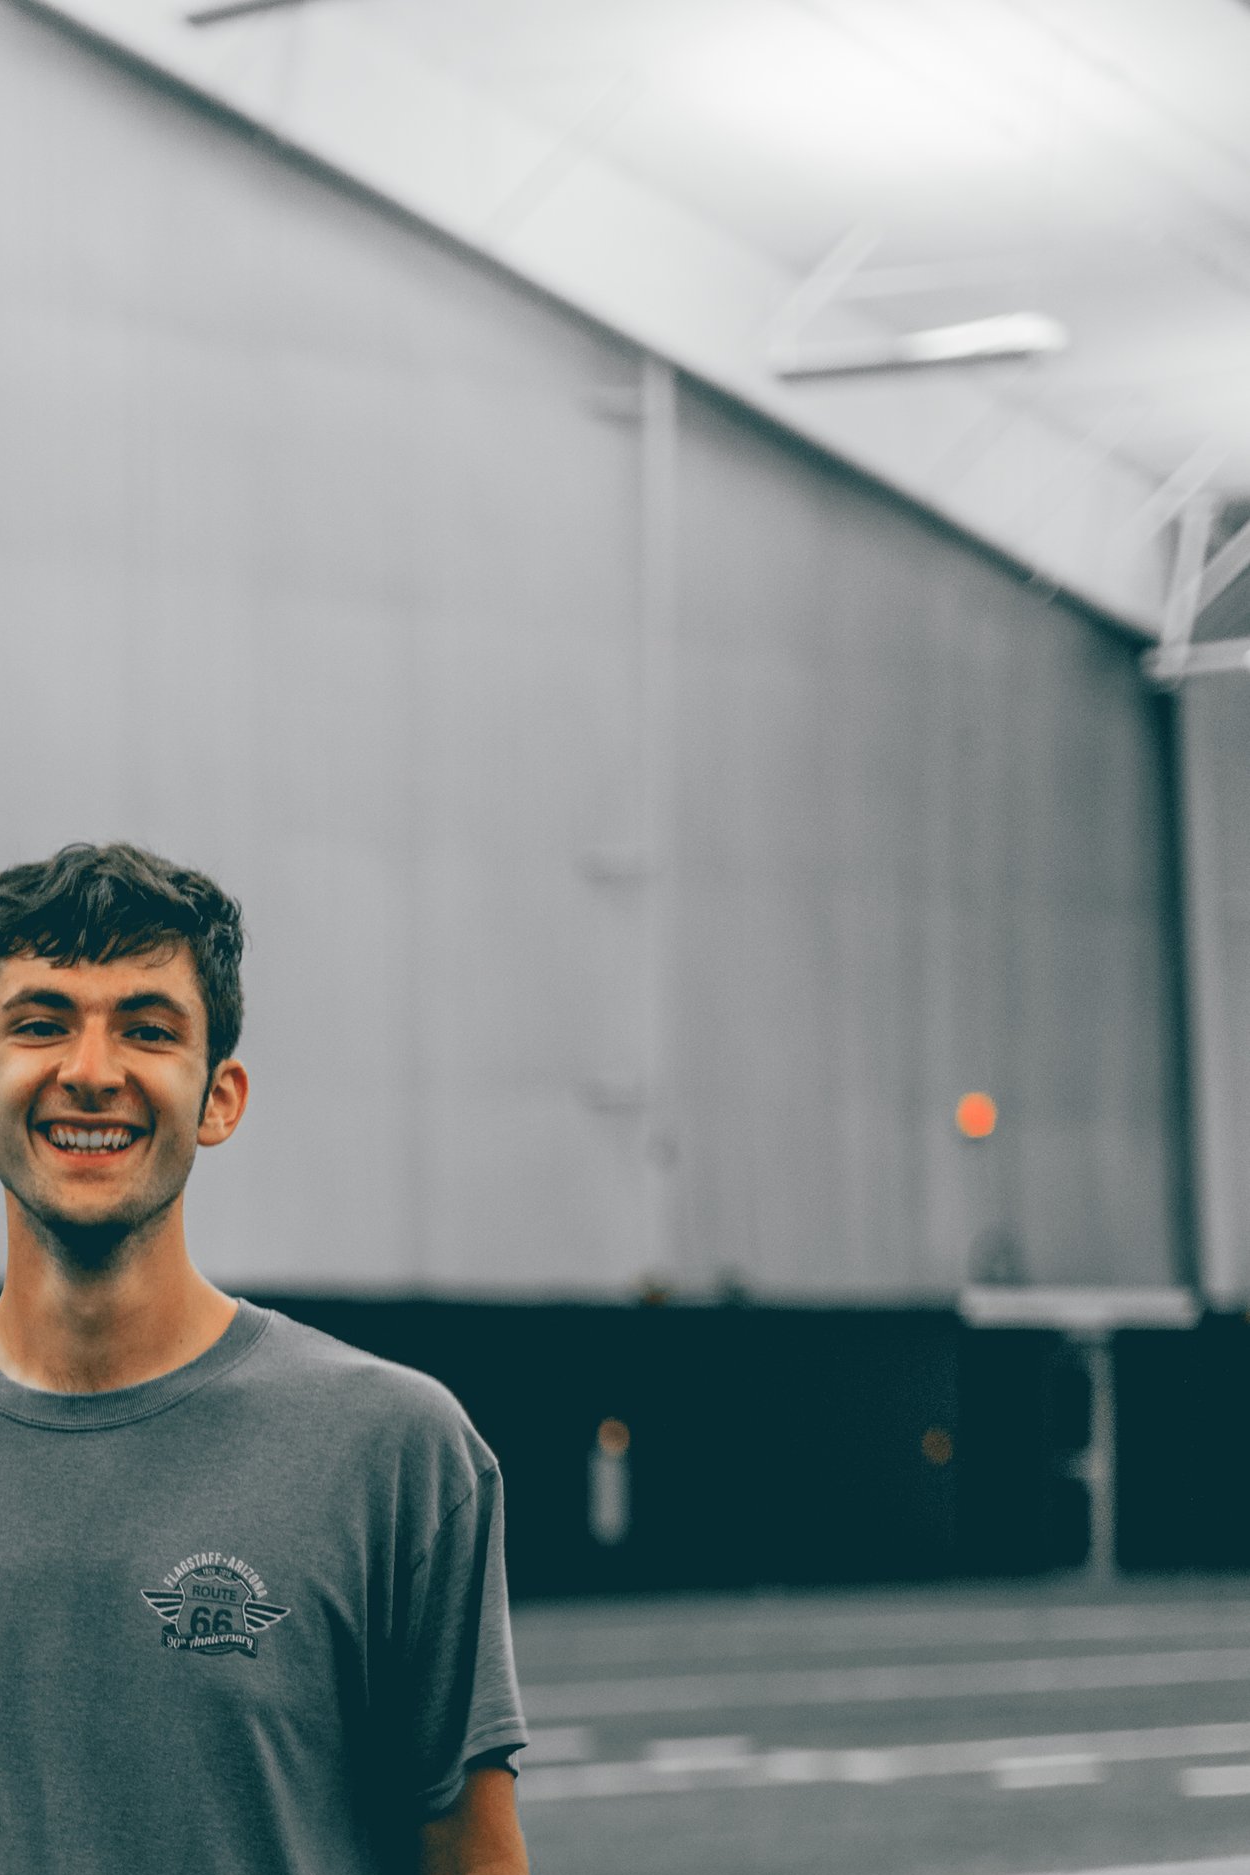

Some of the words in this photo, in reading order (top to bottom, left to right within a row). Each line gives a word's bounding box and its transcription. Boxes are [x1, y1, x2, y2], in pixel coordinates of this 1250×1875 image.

[163, 1552, 223, 1588] FLAGSTAFF
[227, 1556, 268, 1598] ARIZONA
[192, 1585, 238, 1601] ROUTE
[190, 1606, 233, 1634] 66
[189, 1632, 254, 1650] Anniversary
